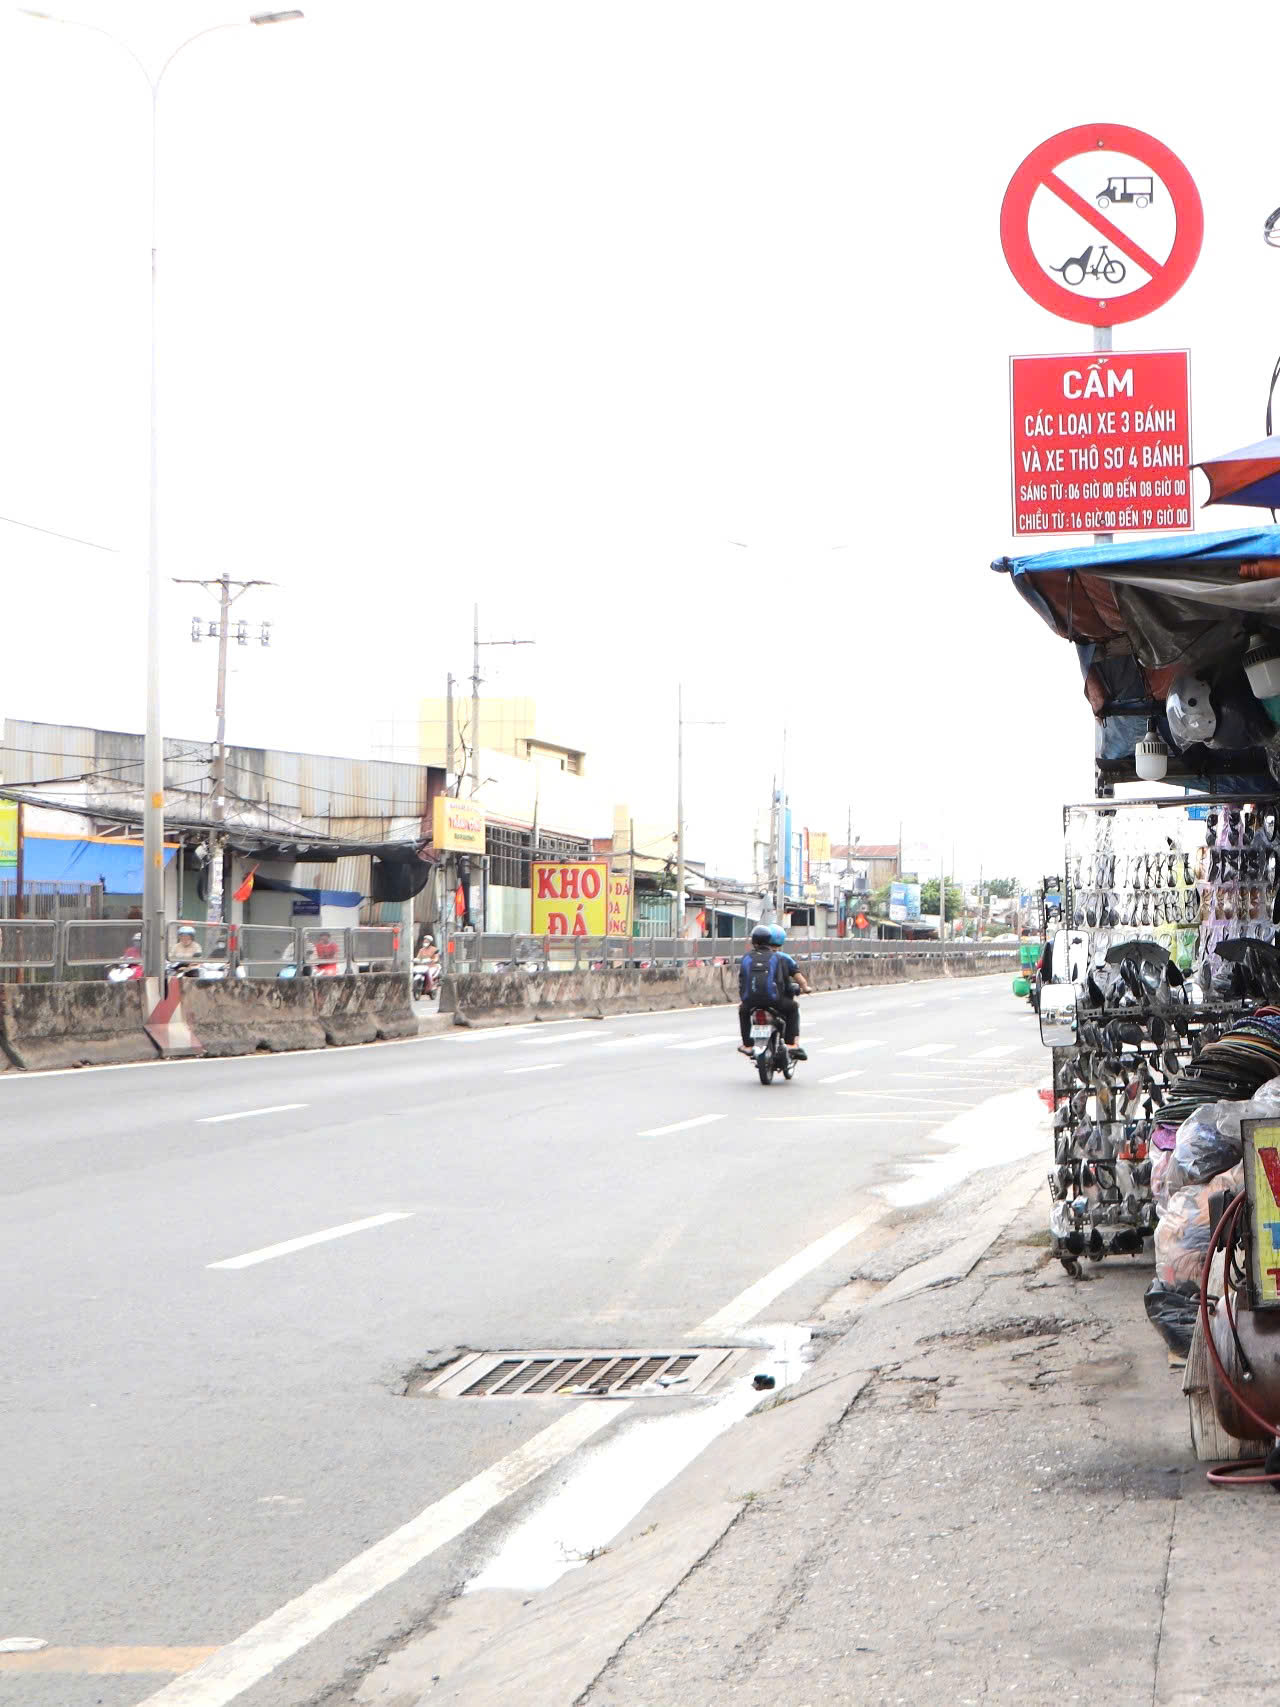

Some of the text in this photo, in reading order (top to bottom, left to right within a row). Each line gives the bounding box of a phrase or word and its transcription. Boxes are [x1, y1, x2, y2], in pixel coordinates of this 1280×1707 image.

[1063, 359, 1134, 399] CẤM
[1025, 405, 1176, 438] CÁC LOẠI XE 3 BÁNH
[1021, 440, 1184, 472] VÀ XE THÔ SƠ 4 BÁNH
[1020, 480, 1047, 501] SÁNG
[1083, 479, 1100, 499] GIỜ
[1102, 482, 1114, 498] 00
[1116, 476, 1137, 498] ĐẾN
[1140, 481, 1152, 497] 08
[1154, 475, 1171, 497] GIỜ
[1174, 480, 1186, 496] 00
[1019, 507, 1049, 530] CHIỀU
[1085, 507, 1103, 528] GIỜ
[1104, 511, 1116, 527] 00
[1118, 504, 1139, 527] ĐẾN
[1142, 509, 1153, 526] 19
[1156, 504, 1174, 525] GIỜ
[1176, 508, 1188, 525] 00
[538, 868, 601, 899] KHO
[548, 903, 588, 942] ĐÁ
